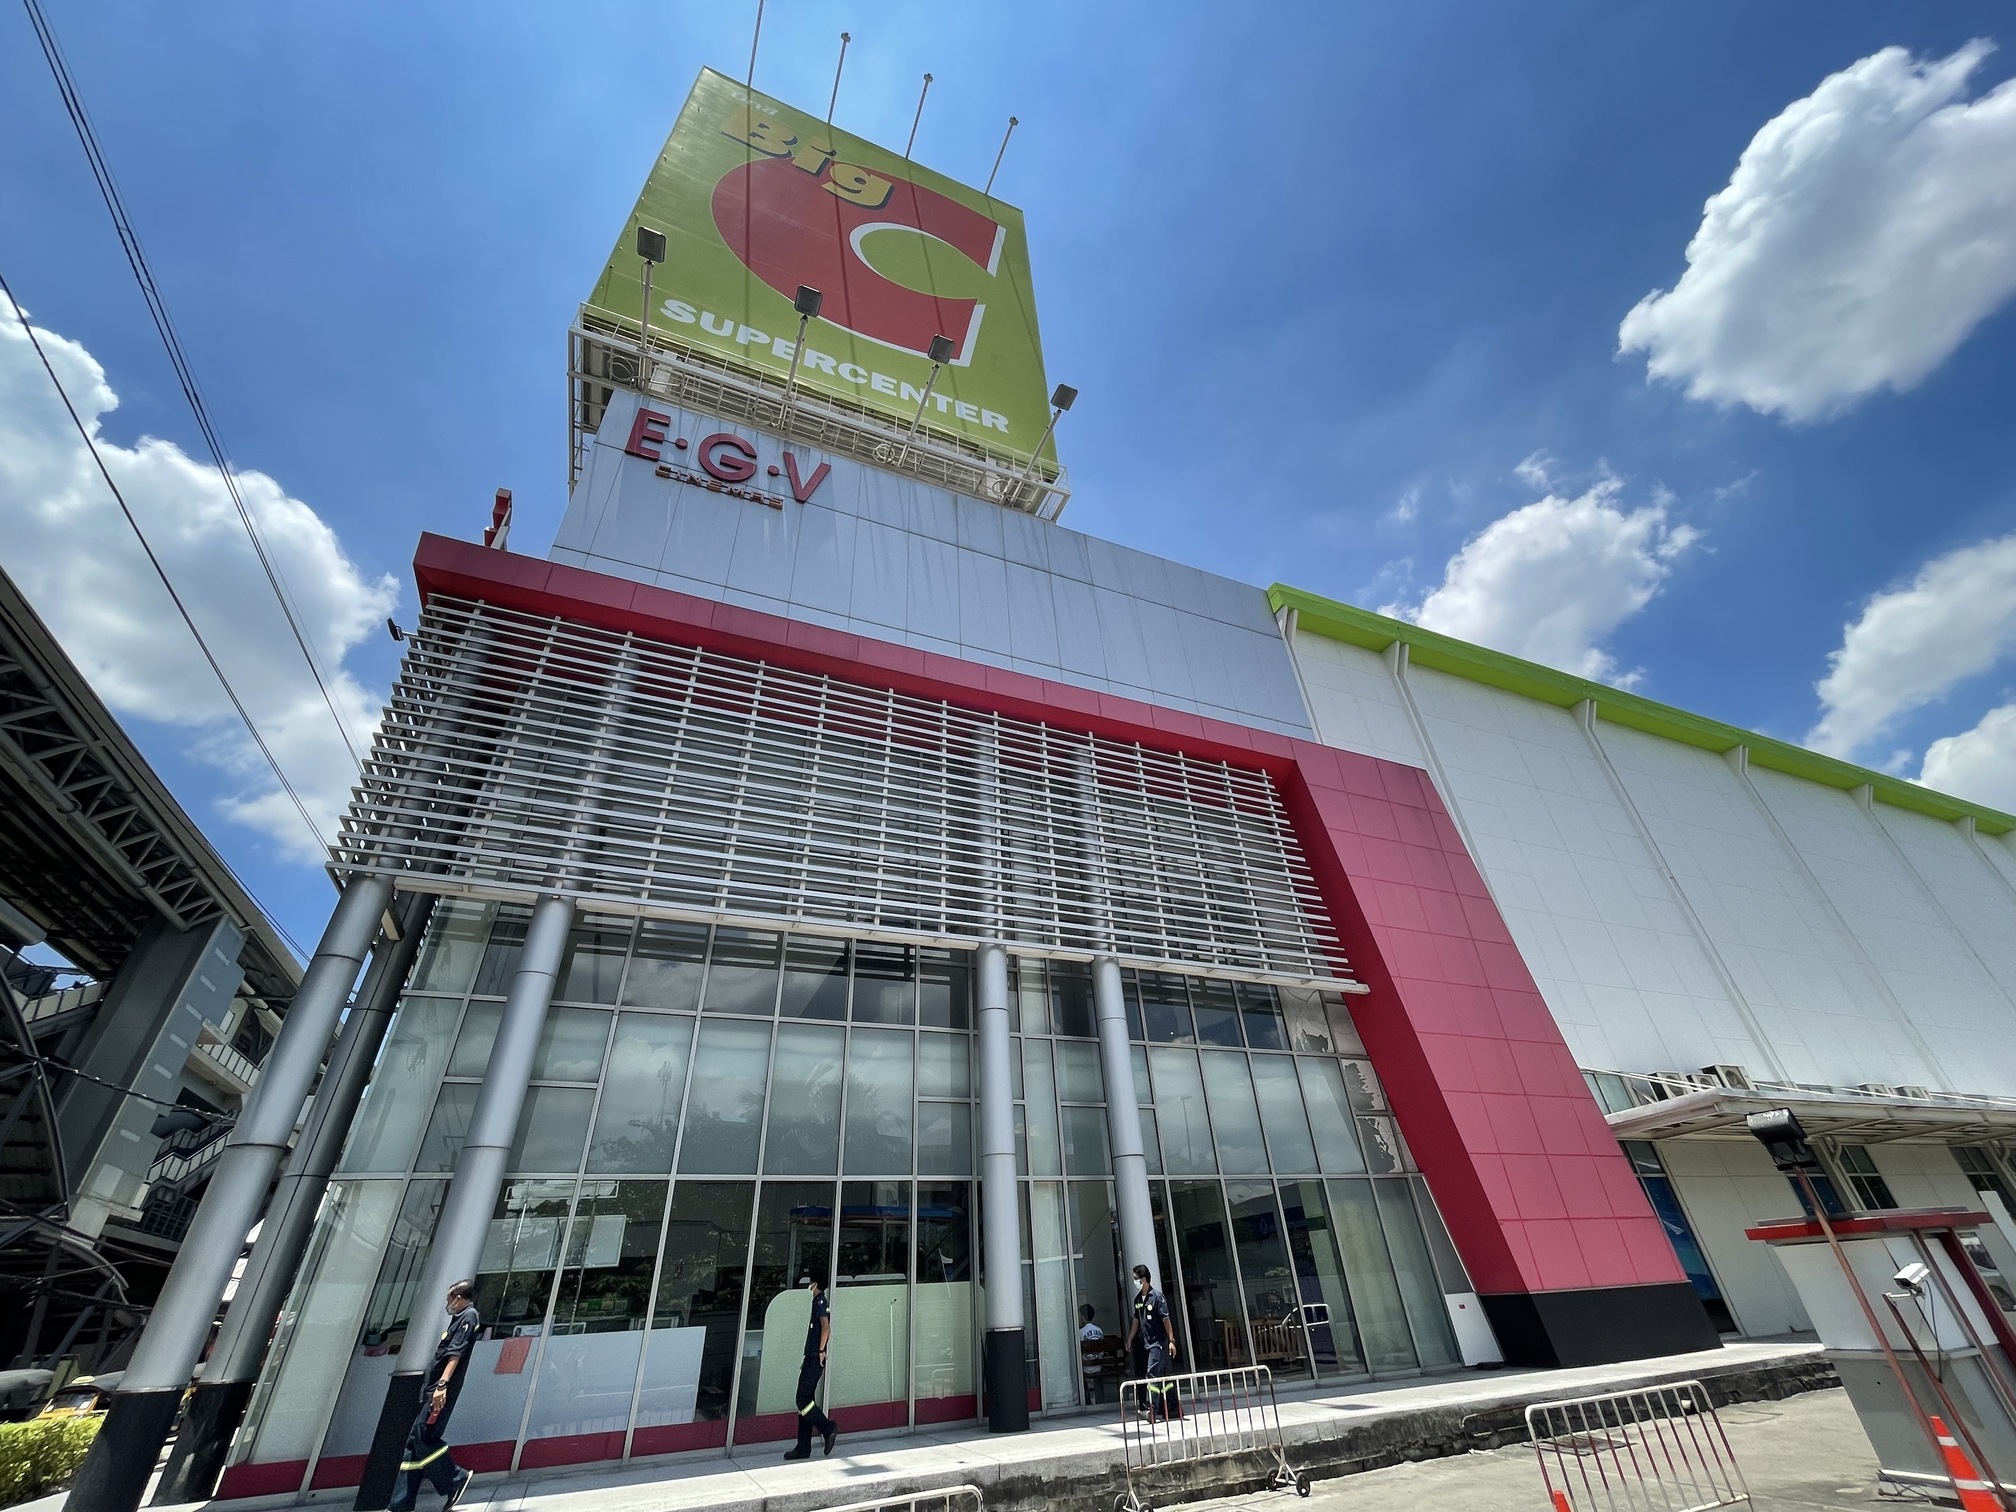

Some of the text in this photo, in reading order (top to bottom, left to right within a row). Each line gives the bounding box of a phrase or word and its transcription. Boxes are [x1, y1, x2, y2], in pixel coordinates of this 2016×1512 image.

[711, 107, 1006, 367] Big C
[659, 299, 1010, 434] SUPERCENTER
[655, 463, 784, 510] CINEMAS
